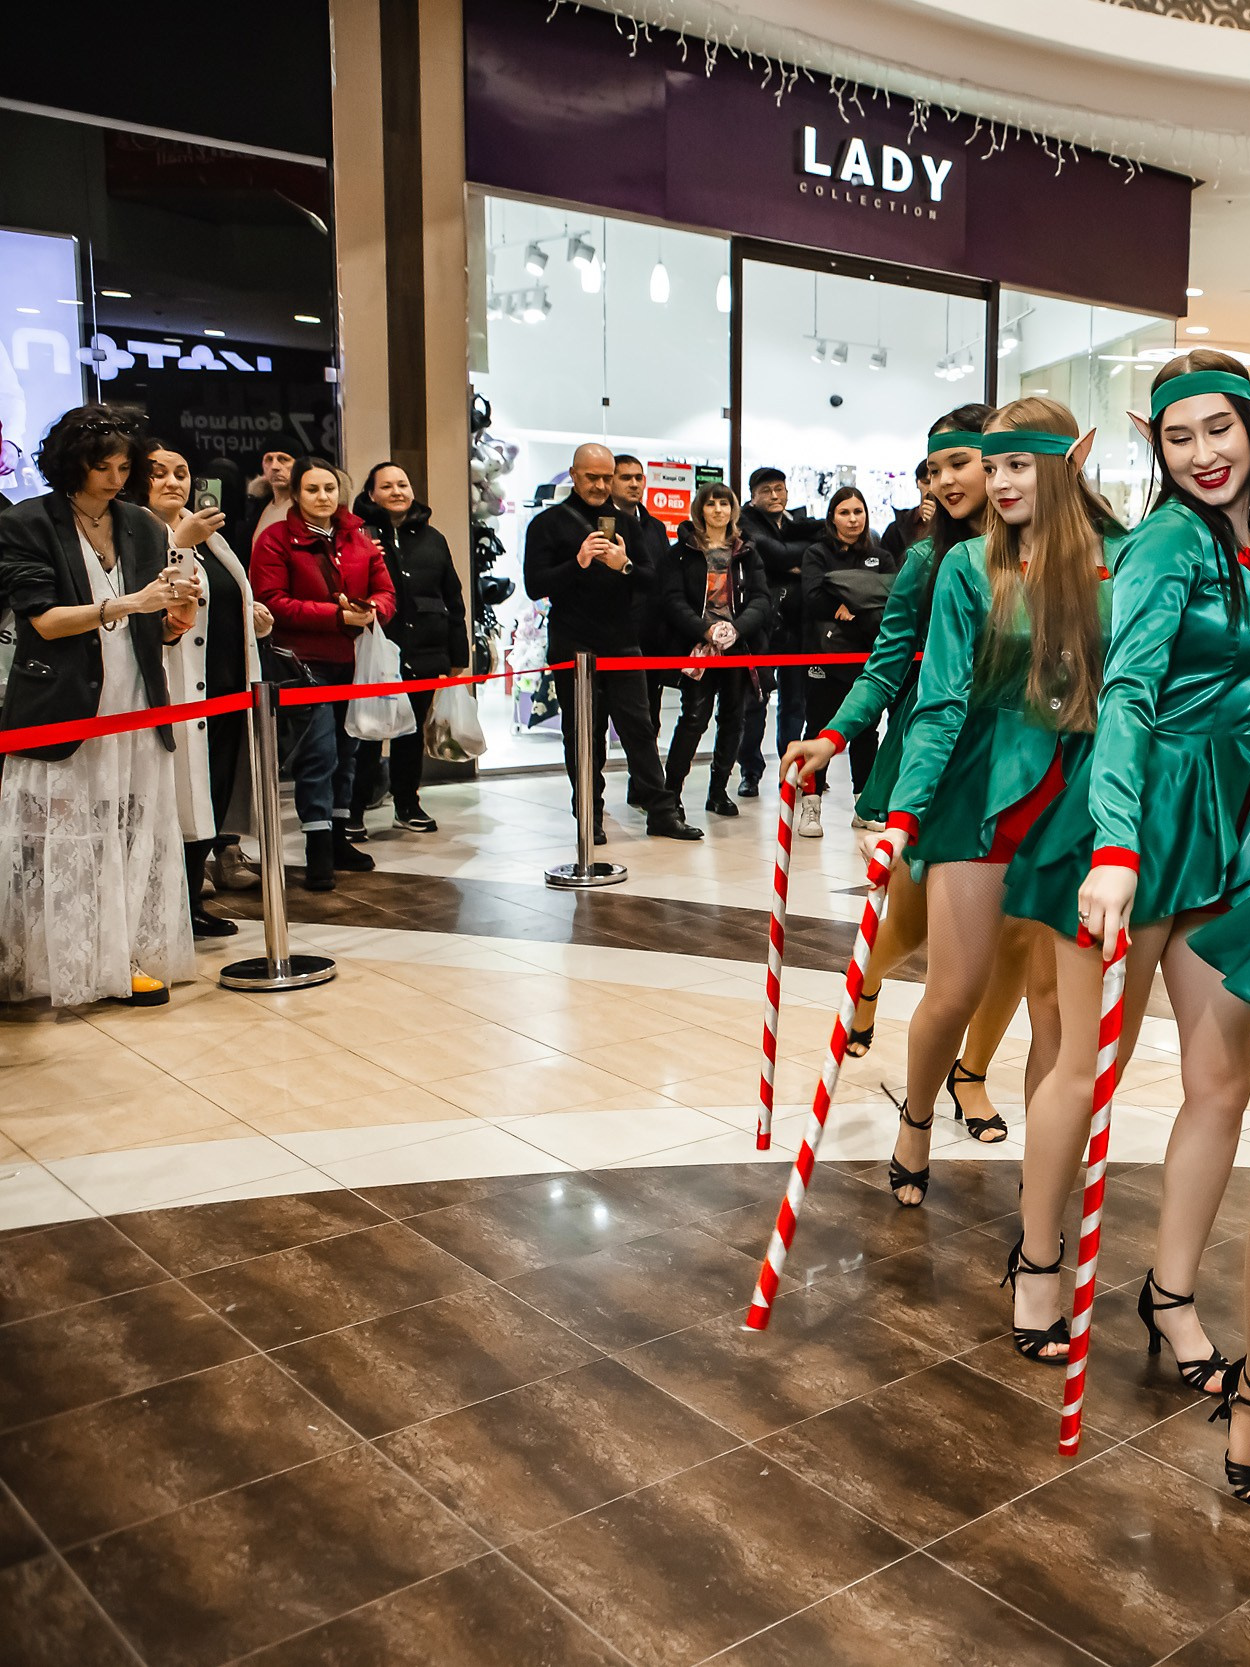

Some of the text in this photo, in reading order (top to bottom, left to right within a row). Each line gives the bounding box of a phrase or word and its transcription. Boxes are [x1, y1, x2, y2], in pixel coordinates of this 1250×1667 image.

[804, 126, 953, 202] LADY
[799, 182, 937, 220] COLLECTION
[668, 499, 684, 509] RED
